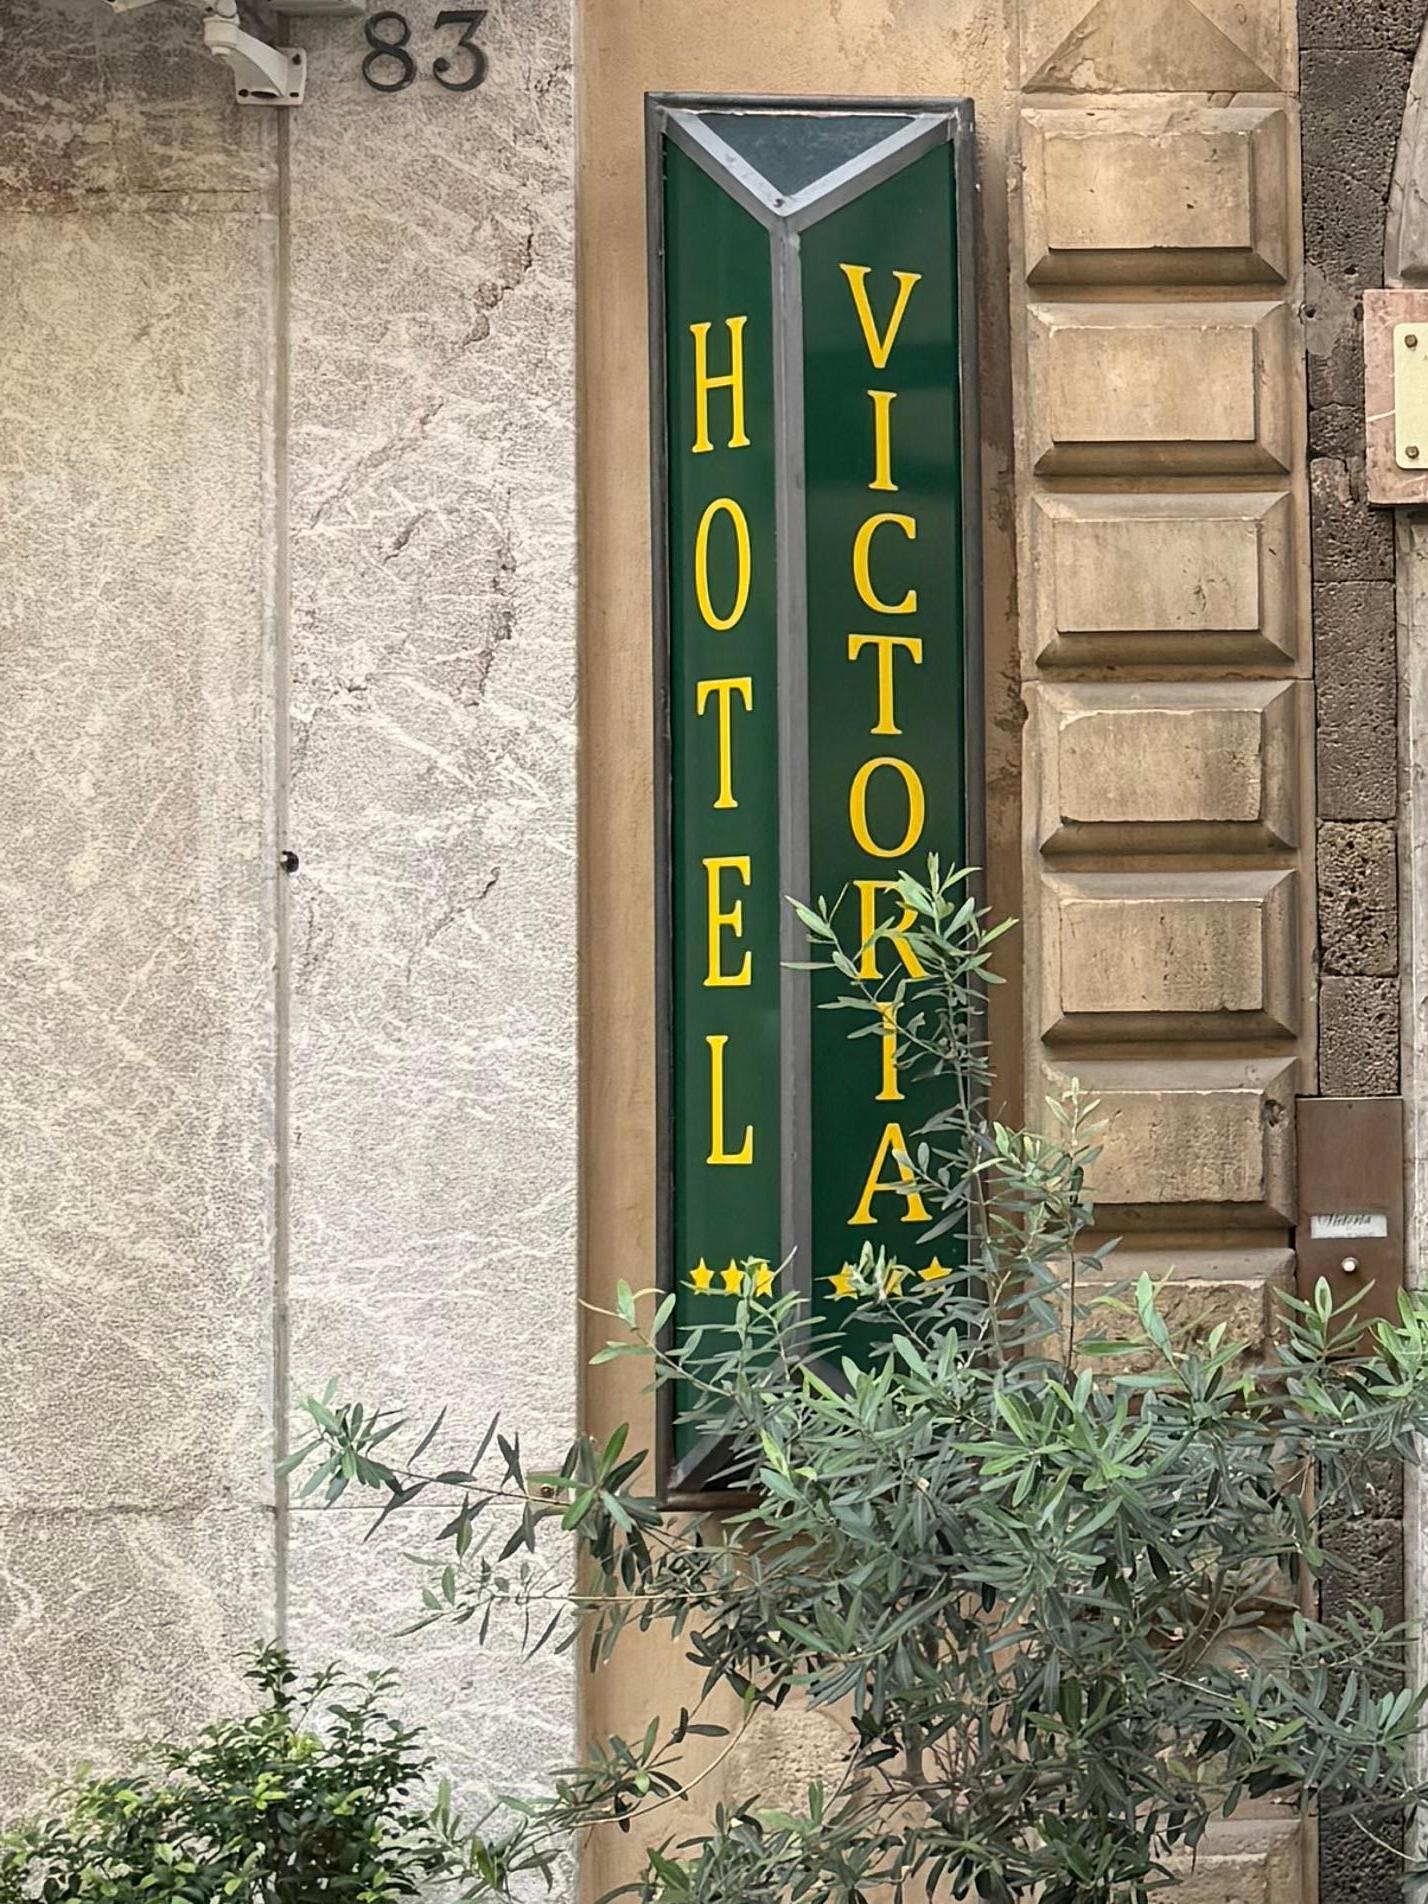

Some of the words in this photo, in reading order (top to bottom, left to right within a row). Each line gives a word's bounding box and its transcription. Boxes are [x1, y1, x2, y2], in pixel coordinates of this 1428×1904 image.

[362, 10, 488, 92] 83
[689, 315, 753, 1165] HOTEL
[839, 262, 933, 1225] VICTORIA
